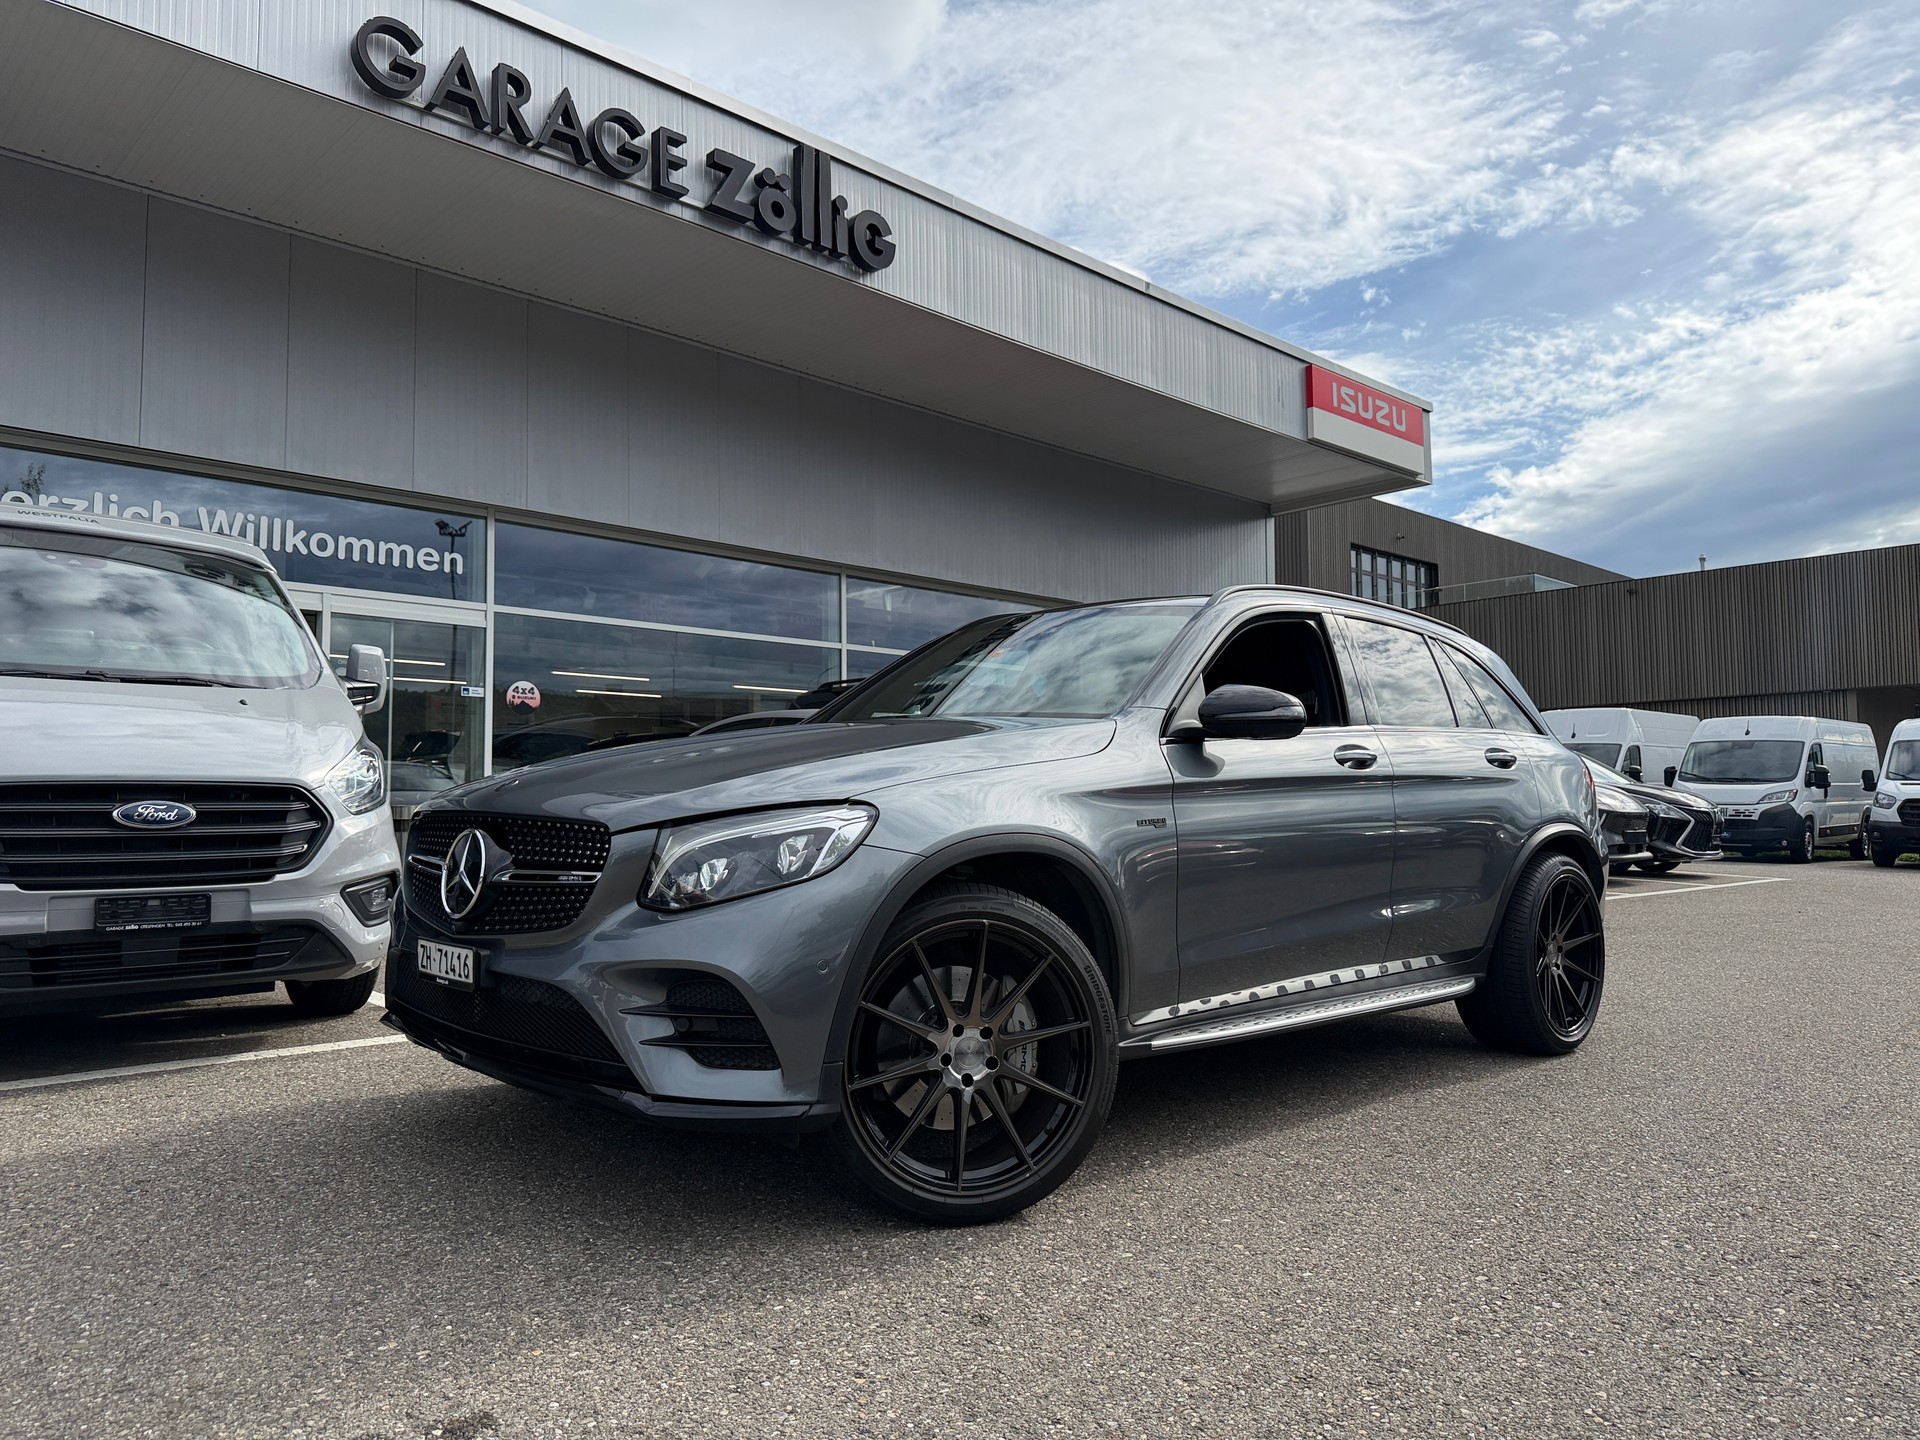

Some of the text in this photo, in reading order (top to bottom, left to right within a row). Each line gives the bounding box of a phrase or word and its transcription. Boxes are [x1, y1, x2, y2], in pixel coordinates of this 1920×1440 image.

[350, 16, 690, 200] GARAGE
[1331, 381, 1407, 432] ISUZU
[17, 509, 100, 524] WESTFALIA
[198, 506, 464, 575] Willkommen
[512, 685, 536, 696] 4x4
[134, 804, 180, 821] Ford
[1084, 965, 1111, 1035] BRIDGESTONE
